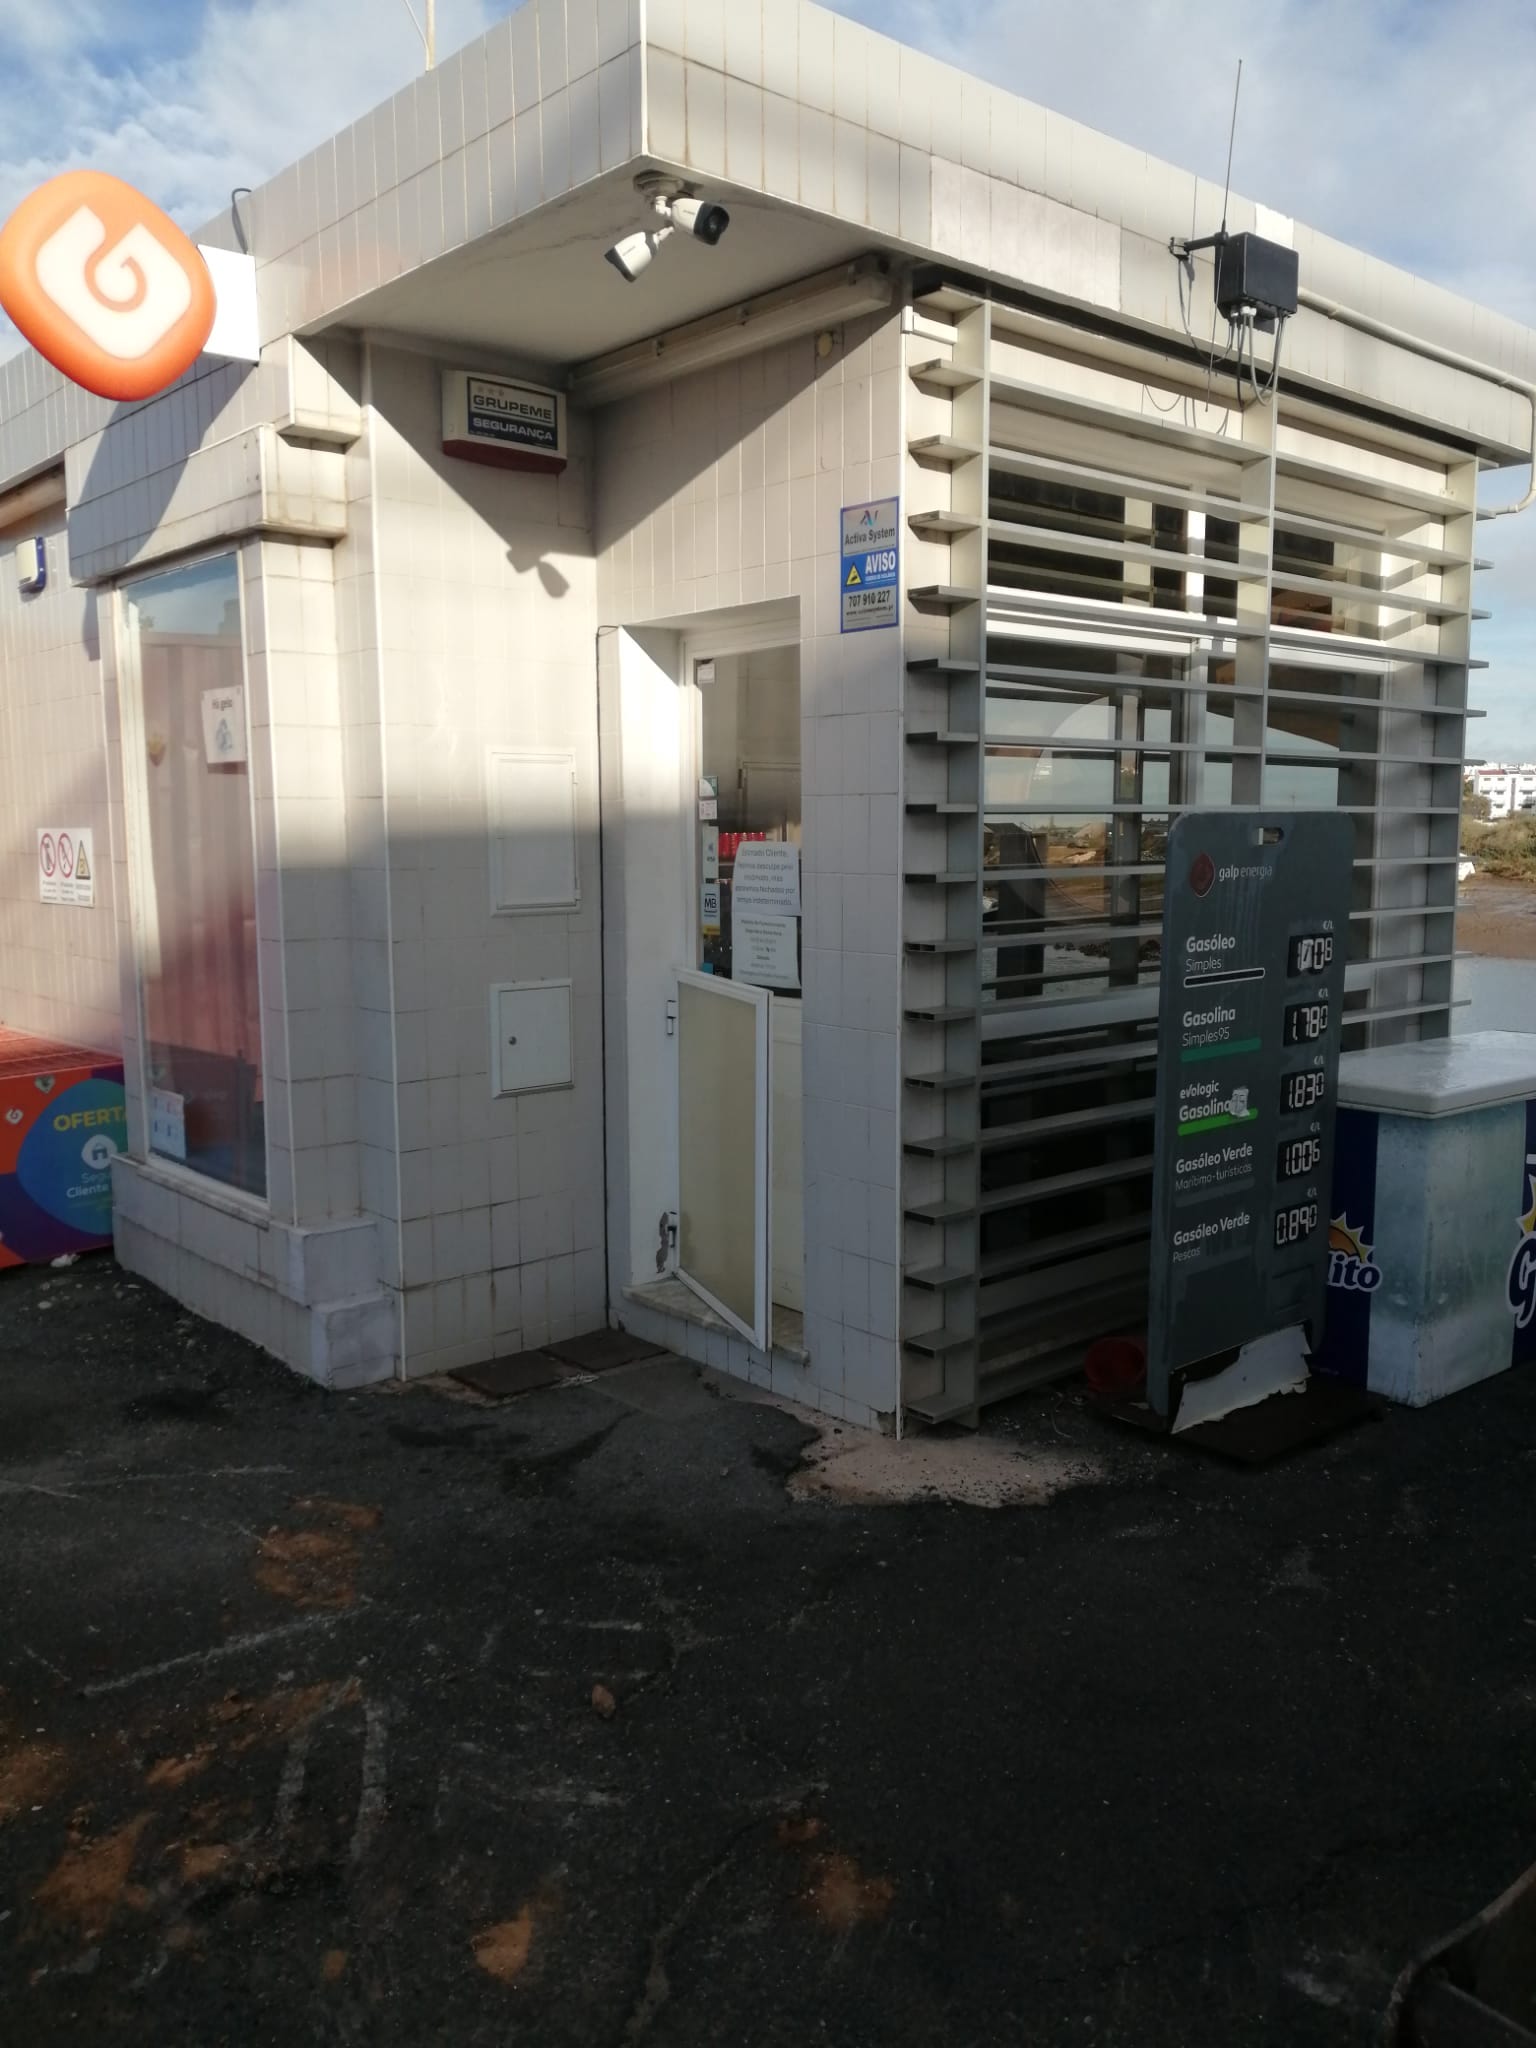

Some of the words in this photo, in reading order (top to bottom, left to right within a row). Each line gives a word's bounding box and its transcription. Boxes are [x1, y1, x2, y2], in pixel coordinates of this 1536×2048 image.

[473, 395, 552, 420] GRUPEME
[472, 417, 553, 441] SEGURANÇA
[845, 532, 867, 545] Activa
[868, 527, 895, 543] System
[865, 550, 896, 575] AVISO
[848, 595, 861, 609] 707
[863, 593, 876, 607] 910
[877, 590, 890, 604] 227
[1218, 864, 1240, 882] galp
[1240, 863, 1273, 881] energia
[704, 898, 718, 911] MB
[1185, 933, 1236, 953] Gasóleo
[1185, 957, 1222, 972] Simples
[1182, 1006, 1236, 1028] Gasolina
[1179, 1080, 1220, 1100] evologic
[53, 1105, 126, 1132] OFERT
[1175, 1152, 1221, 1174] Gasóleo
[1222, 1142, 1254, 1162] Verde
[1173, 1223, 1219, 1246] Gasóleo
[1219, 1212, 1250, 1231] Verde
[1172, 1246, 1202, 1264] Pescas
